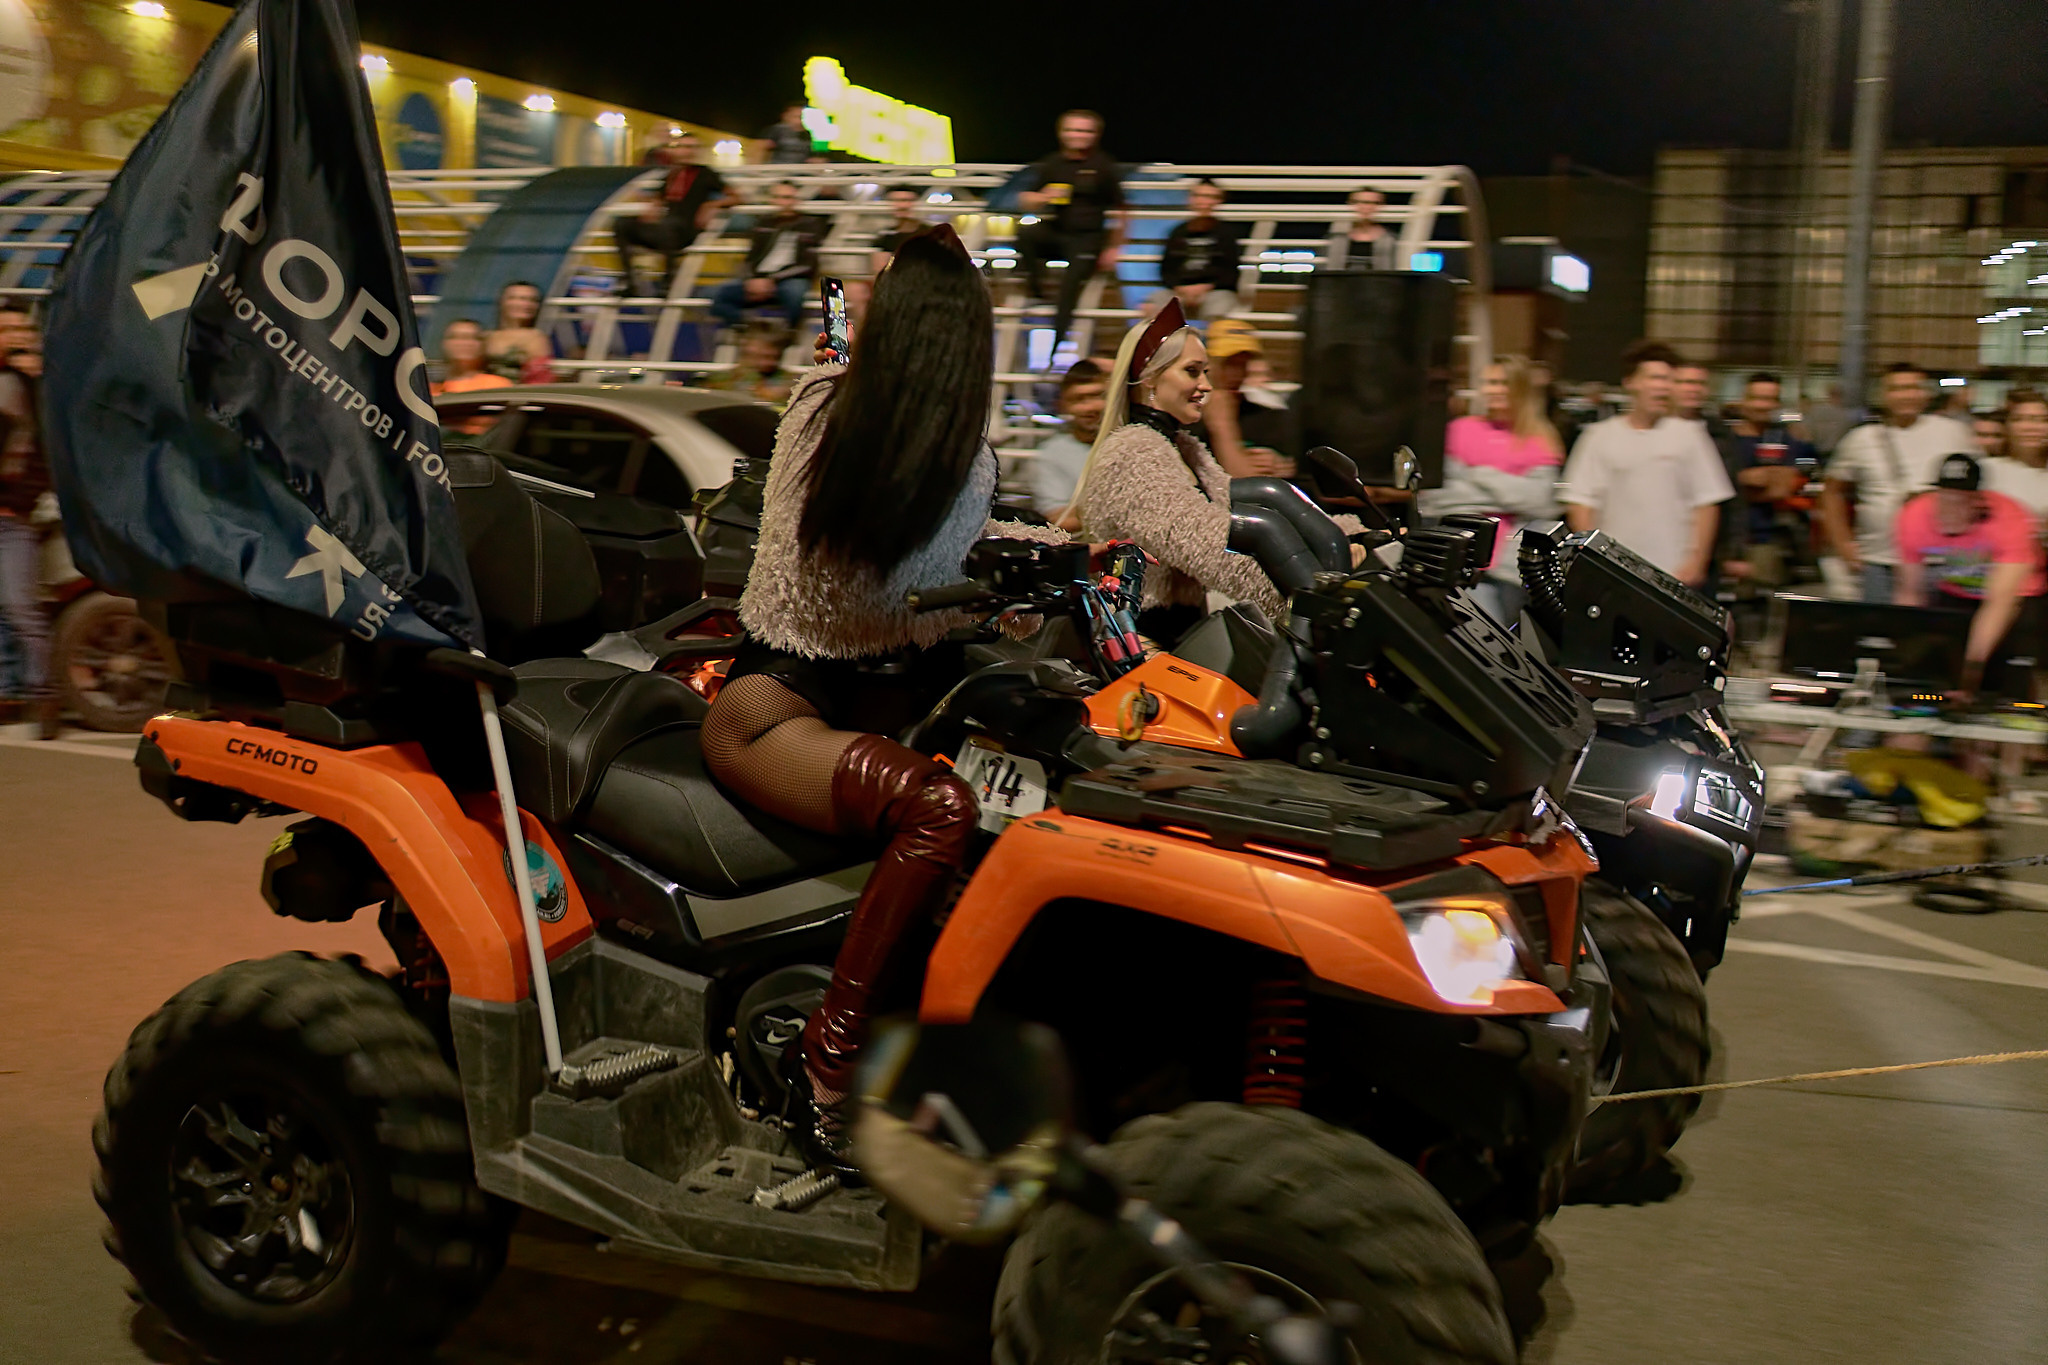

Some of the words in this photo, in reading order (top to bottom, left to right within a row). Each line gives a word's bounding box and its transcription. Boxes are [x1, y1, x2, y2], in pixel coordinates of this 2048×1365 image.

[219, 272, 393, 439] МОТОЦЕНТРОВ
[1166, 665, 1201, 682] EPS
[226, 738, 318, 775] CFMOTO
